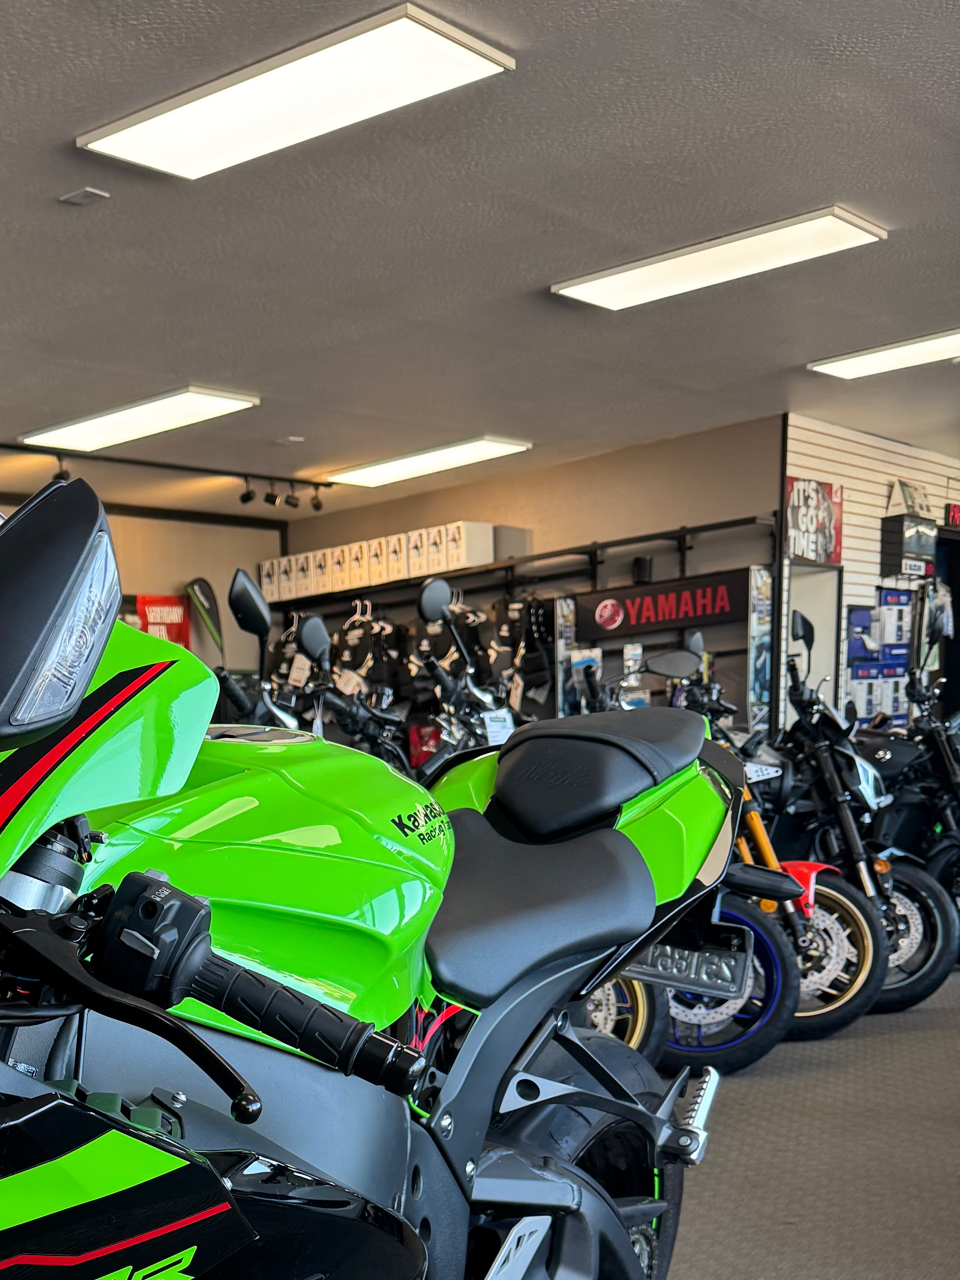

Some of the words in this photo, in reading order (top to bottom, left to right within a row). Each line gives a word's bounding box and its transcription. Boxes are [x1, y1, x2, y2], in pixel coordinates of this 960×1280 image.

[793, 480, 818, 507] IT'S
[798, 506, 817, 533] GO
[625, 585, 730, 626] YAMAHA
